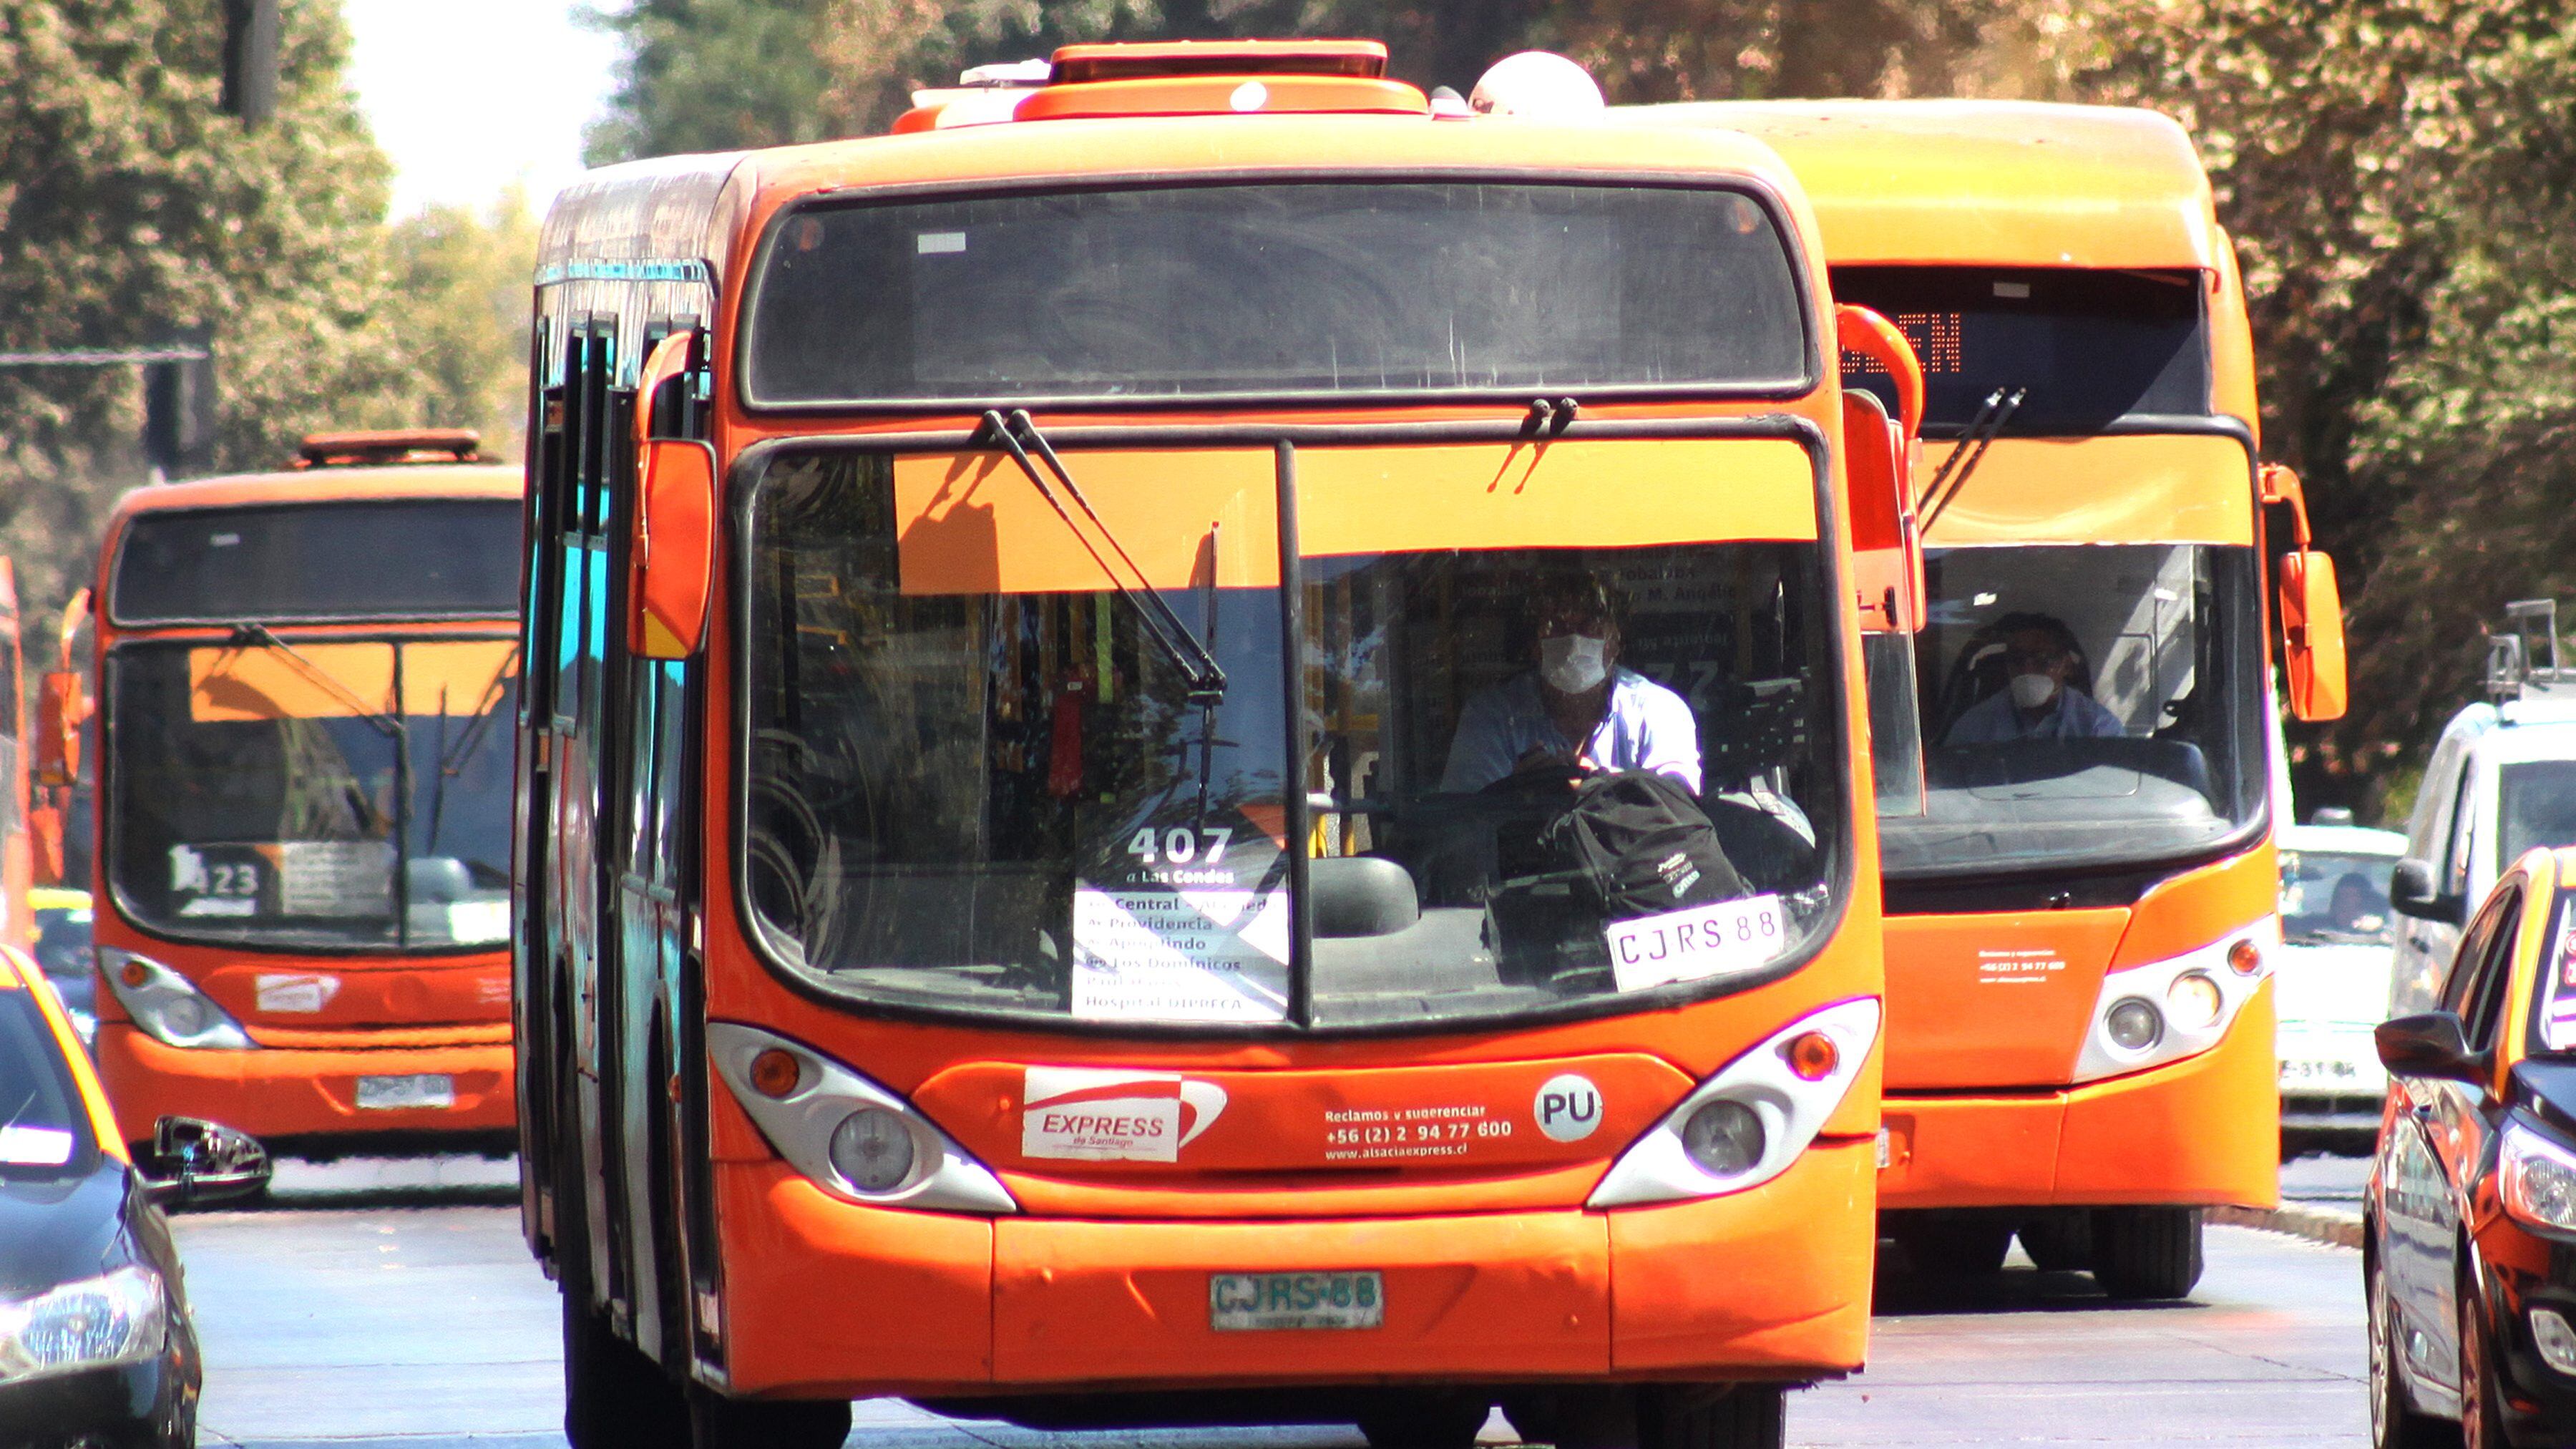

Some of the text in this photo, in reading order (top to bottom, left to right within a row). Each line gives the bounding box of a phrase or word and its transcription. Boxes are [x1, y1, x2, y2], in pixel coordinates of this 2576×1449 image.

[1128, 827, 1234, 863] 407
[1126, 868, 1234, 884] a Las Condes
[1115, 897, 1179, 910] Central
[1110, 917, 1213, 930] Providencia
[1324, 1108, 1389, 1122] Reclamos
[1542, 1091, 1595, 1126] PU
[1042, 1113, 1164, 1137] EXPRESS
[1327, 1121, 1512, 1144] +56 (2) 2 94 77 600
[1088, 1136, 1133, 1147] Santiago
[1325, 1142, 1468, 1160] www.alsaciaexpress.cl
